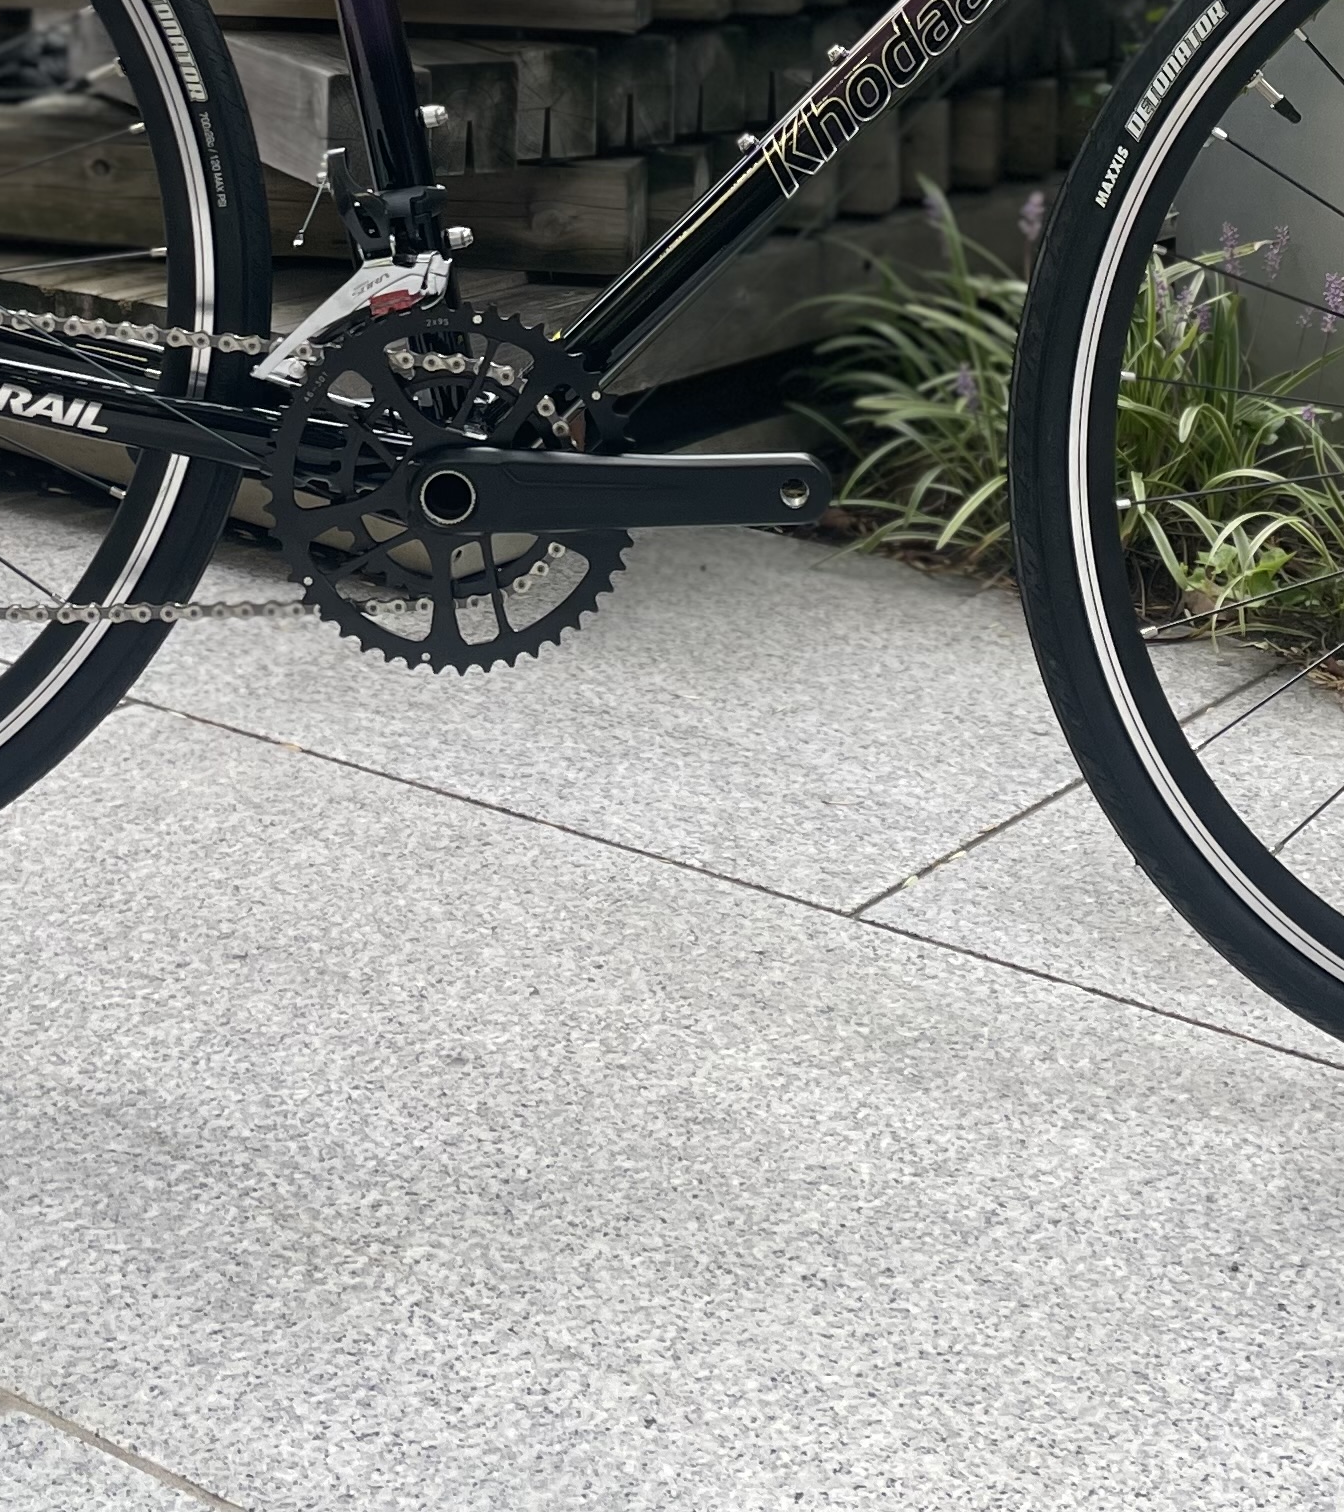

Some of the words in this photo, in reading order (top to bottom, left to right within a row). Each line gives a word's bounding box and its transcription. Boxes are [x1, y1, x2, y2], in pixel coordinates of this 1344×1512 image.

[213, 172, 225, 193] MAX
[1095, 145, 1130, 208] MAXXIS
[216, 193, 227, 207] PSI
